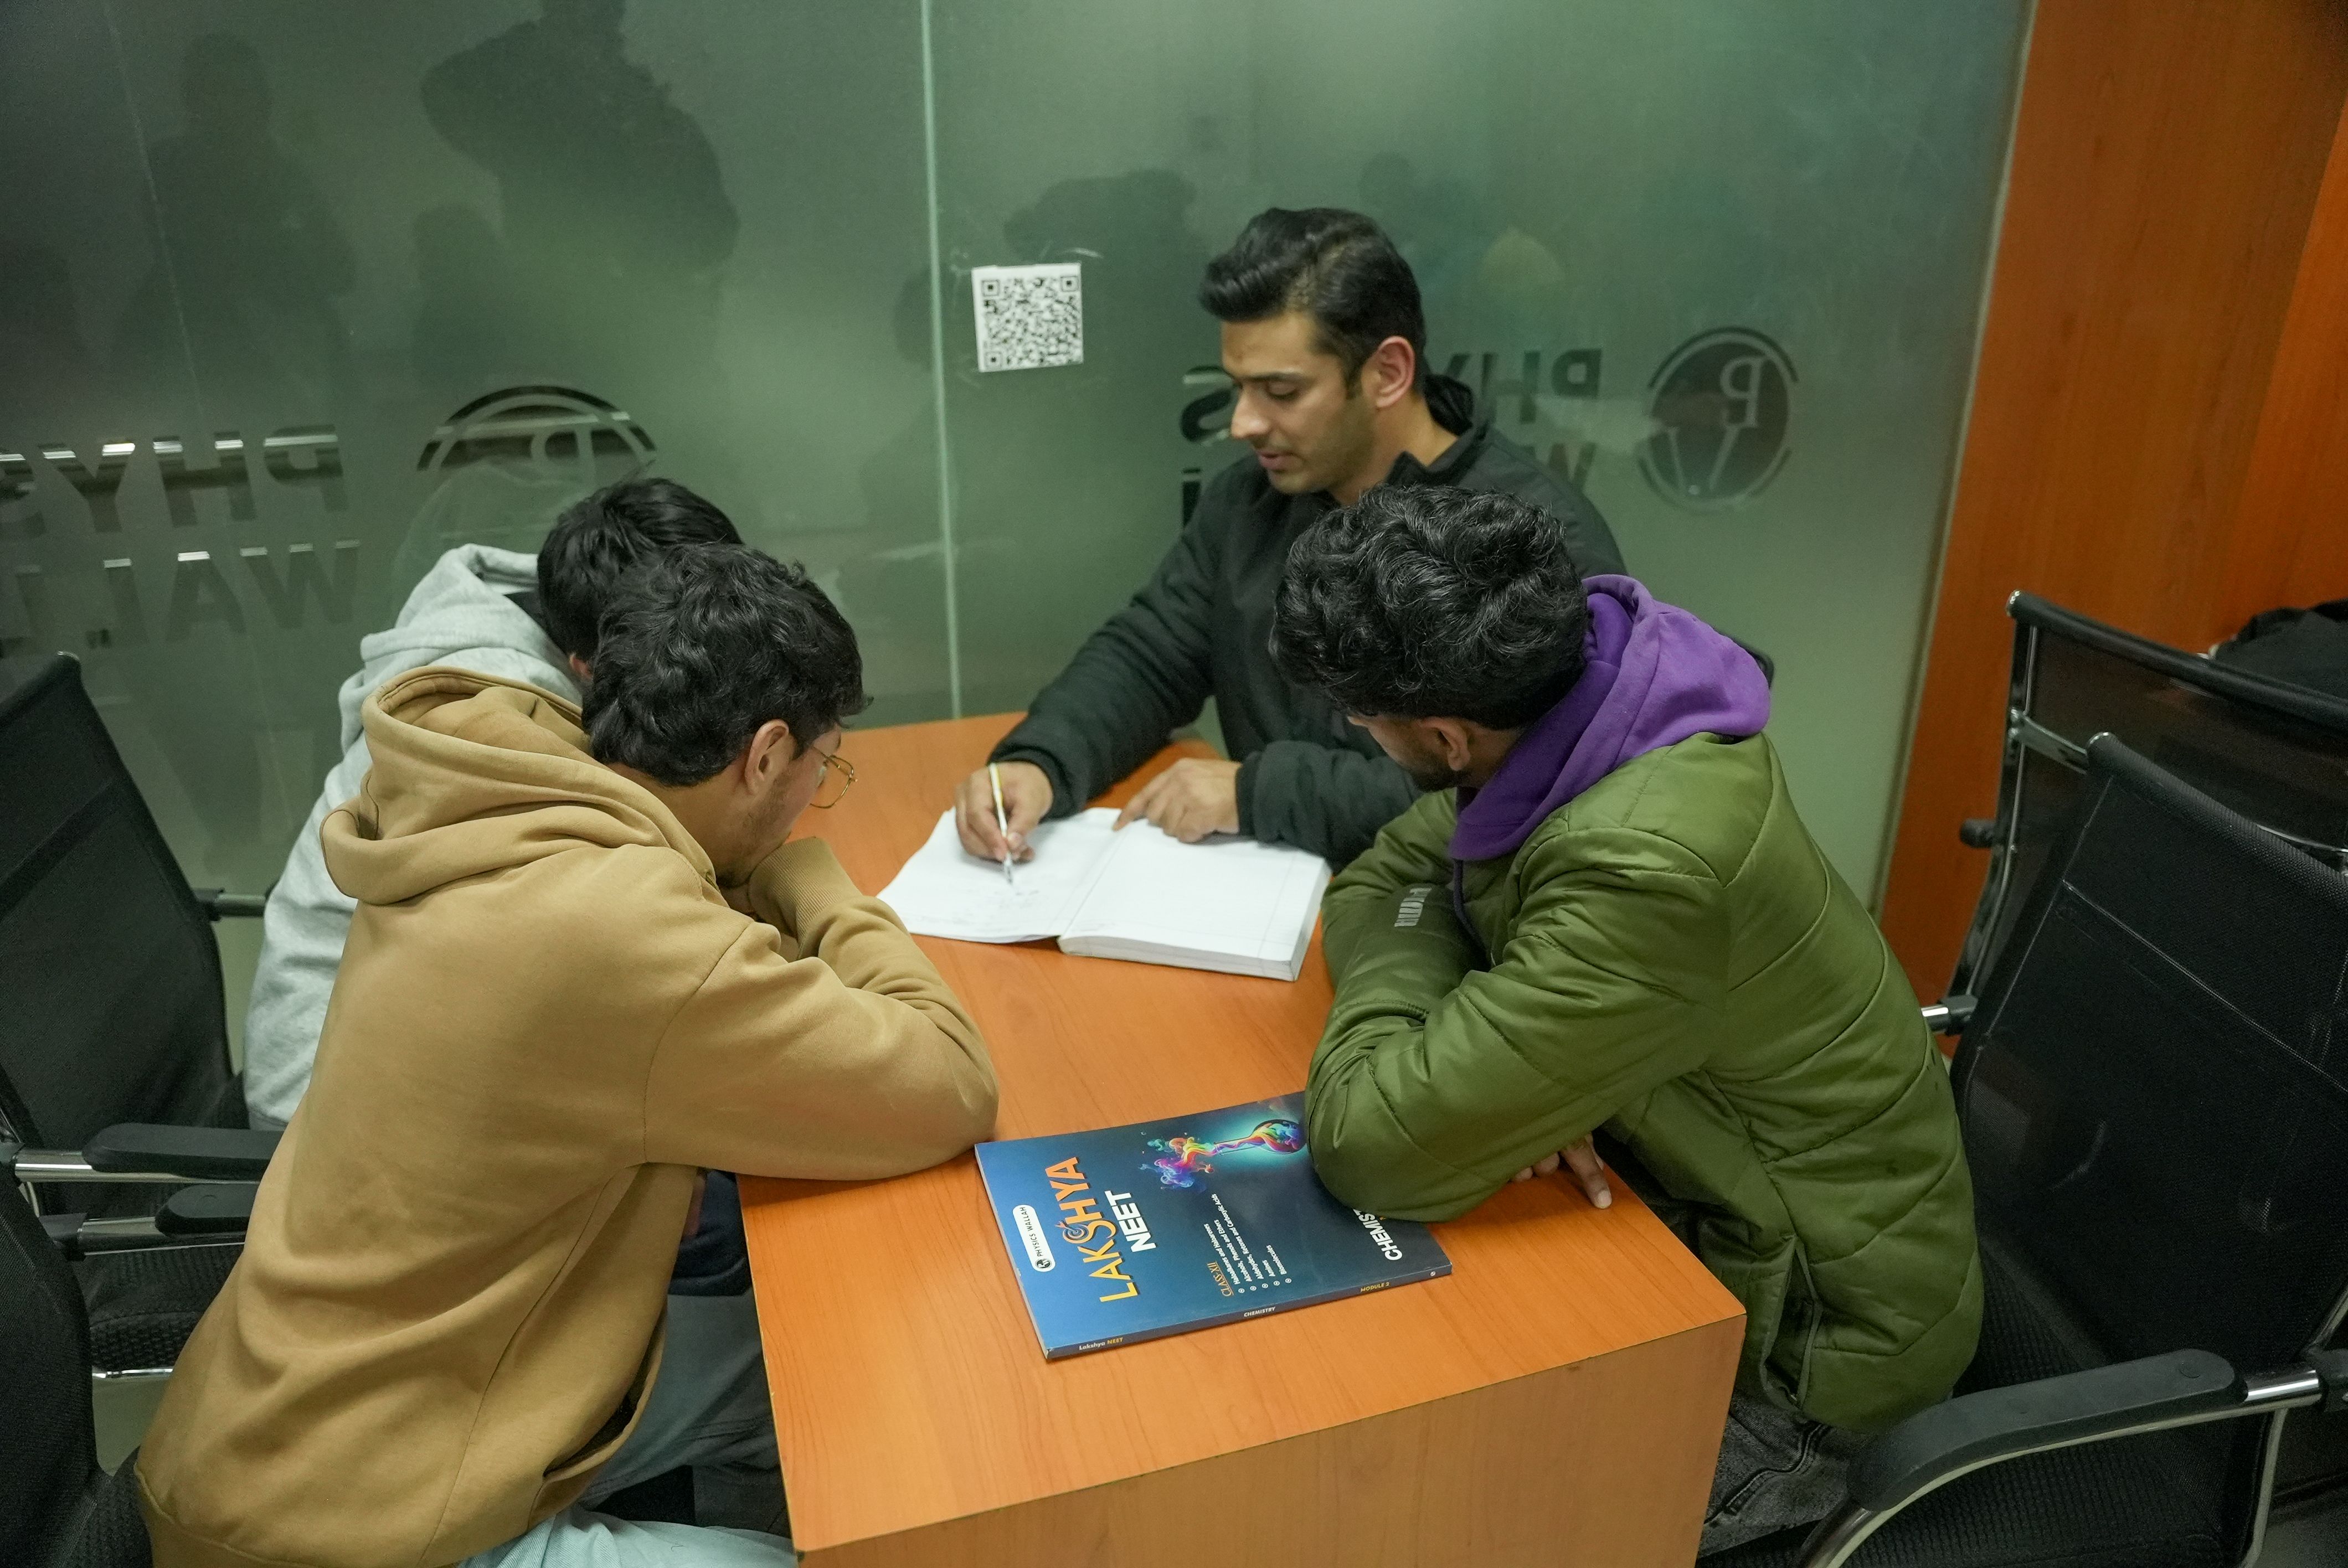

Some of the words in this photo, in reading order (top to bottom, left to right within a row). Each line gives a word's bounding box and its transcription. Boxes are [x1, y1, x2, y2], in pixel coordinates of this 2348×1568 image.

[1211, 1193, 1222, 1205] Acids
[1020, 1206, 1034, 1230] WALLAH
[1105, 1190, 1156, 1252] NEET
[1218, 1205, 1234, 1227] Carboxylic
[1045, 1157, 1139, 1302] LAKSHYA
[1204, 1223, 1220, 1249] Haloarenes
[1214, 1219, 1226, 1234] Ethers
[1229, 1227, 1239, 1236] and
[1028, 1234, 1043, 1257] PHYSICS
[1221, 1234, 1230, 1243] and
[1235, 1236, 1249, 1255] Ketones
[1216, 1248, 1226, 1257] and
[1227, 1242, 1240, 1261] Phenols
[1266, 1245, 1288, 1275] Biomolecules
[1222, 1257, 1240, 1285] Haloalkanes
[1238, 1260, 1252, 1282] Alcohols,
[1247, 1254, 1264, 1279] Aldehydes,
[1262, 1260, 1275, 1277] Amines
[1207, 1261, 1233, 1297] CLASS-XII
[1360, 1282, 1384, 1293] MODULE
[1244, 1306, 1276, 1317] CHEMISTRY
[1079, 1340, 1105, 1351] Lakshya
[1107, 1337, 1124, 1345] NEET
